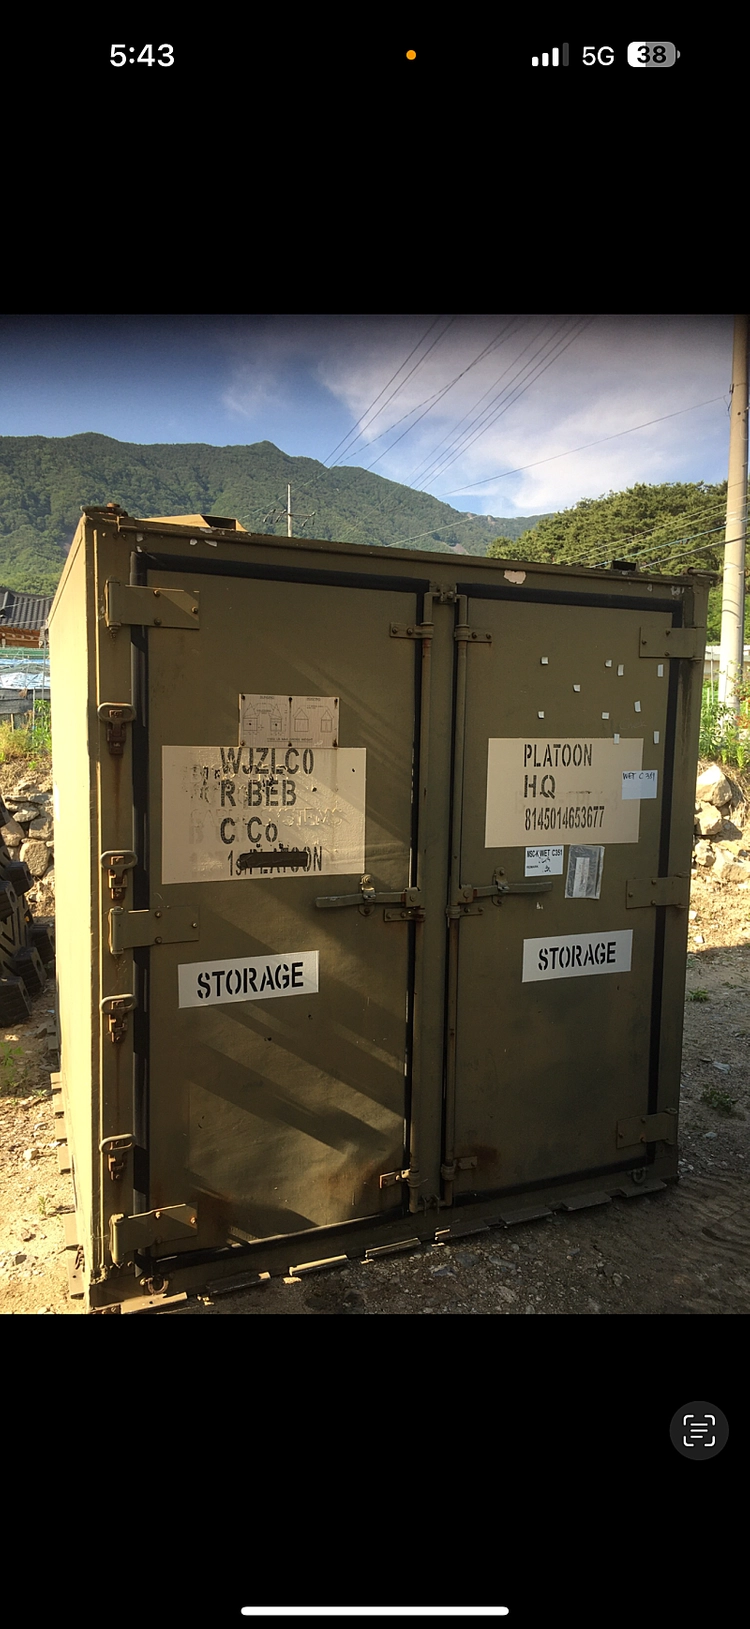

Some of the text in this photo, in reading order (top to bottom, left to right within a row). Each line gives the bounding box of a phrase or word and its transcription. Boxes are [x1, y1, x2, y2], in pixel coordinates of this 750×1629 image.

[523, 743, 593, 767] PLATOON
[220, 779, 236, 807] R
[247, 779, 297, 807] BEB
[523, 774, 556, 799] HQ
[220, 817, 236, 844] C
[525, 805, 605, 831] 8145014653677
[538, 942, 616, 970] STORAGE
[197, 962, 304, 999] STORAGE
